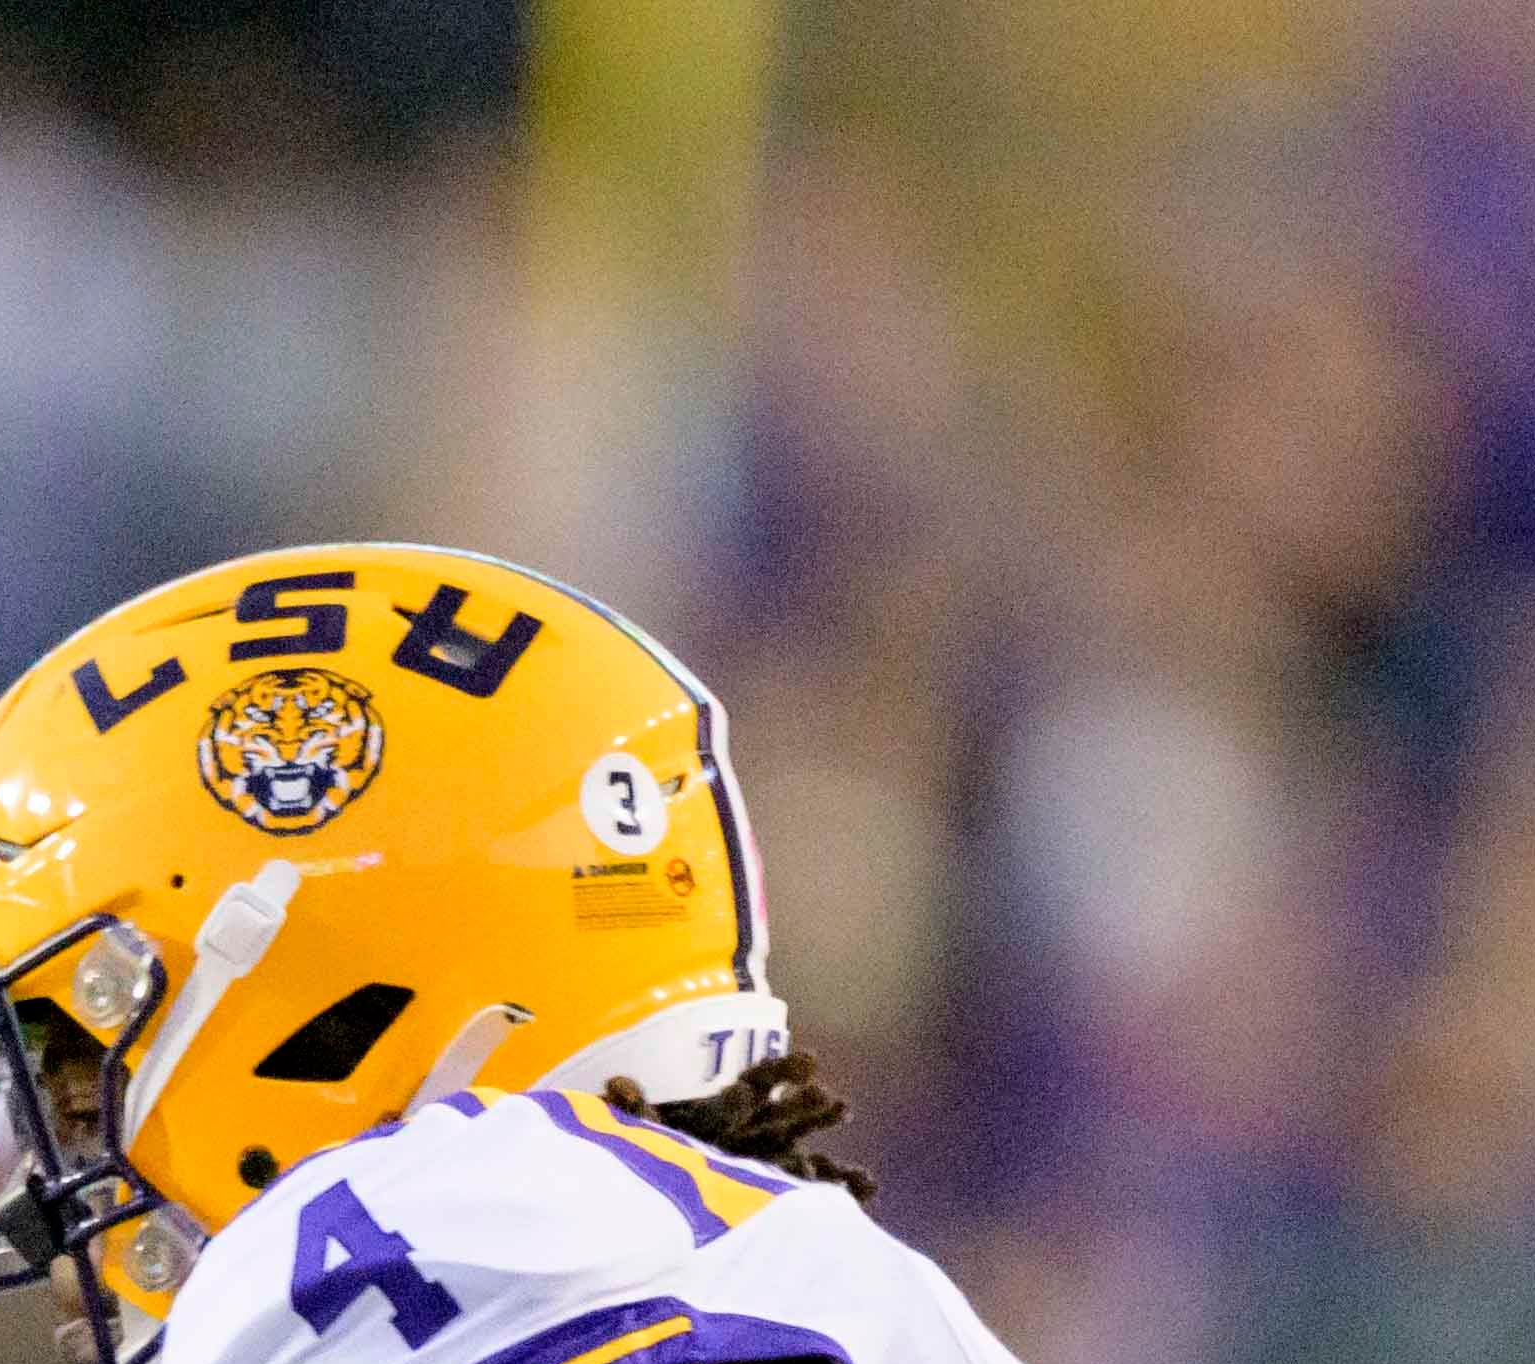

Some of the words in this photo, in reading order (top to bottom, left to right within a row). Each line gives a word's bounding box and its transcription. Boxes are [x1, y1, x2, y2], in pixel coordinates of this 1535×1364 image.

[70, 571, 544, 735] LSU
[608, 771, 643, 836] 3
[288, 1178, 463, 1350] 4
